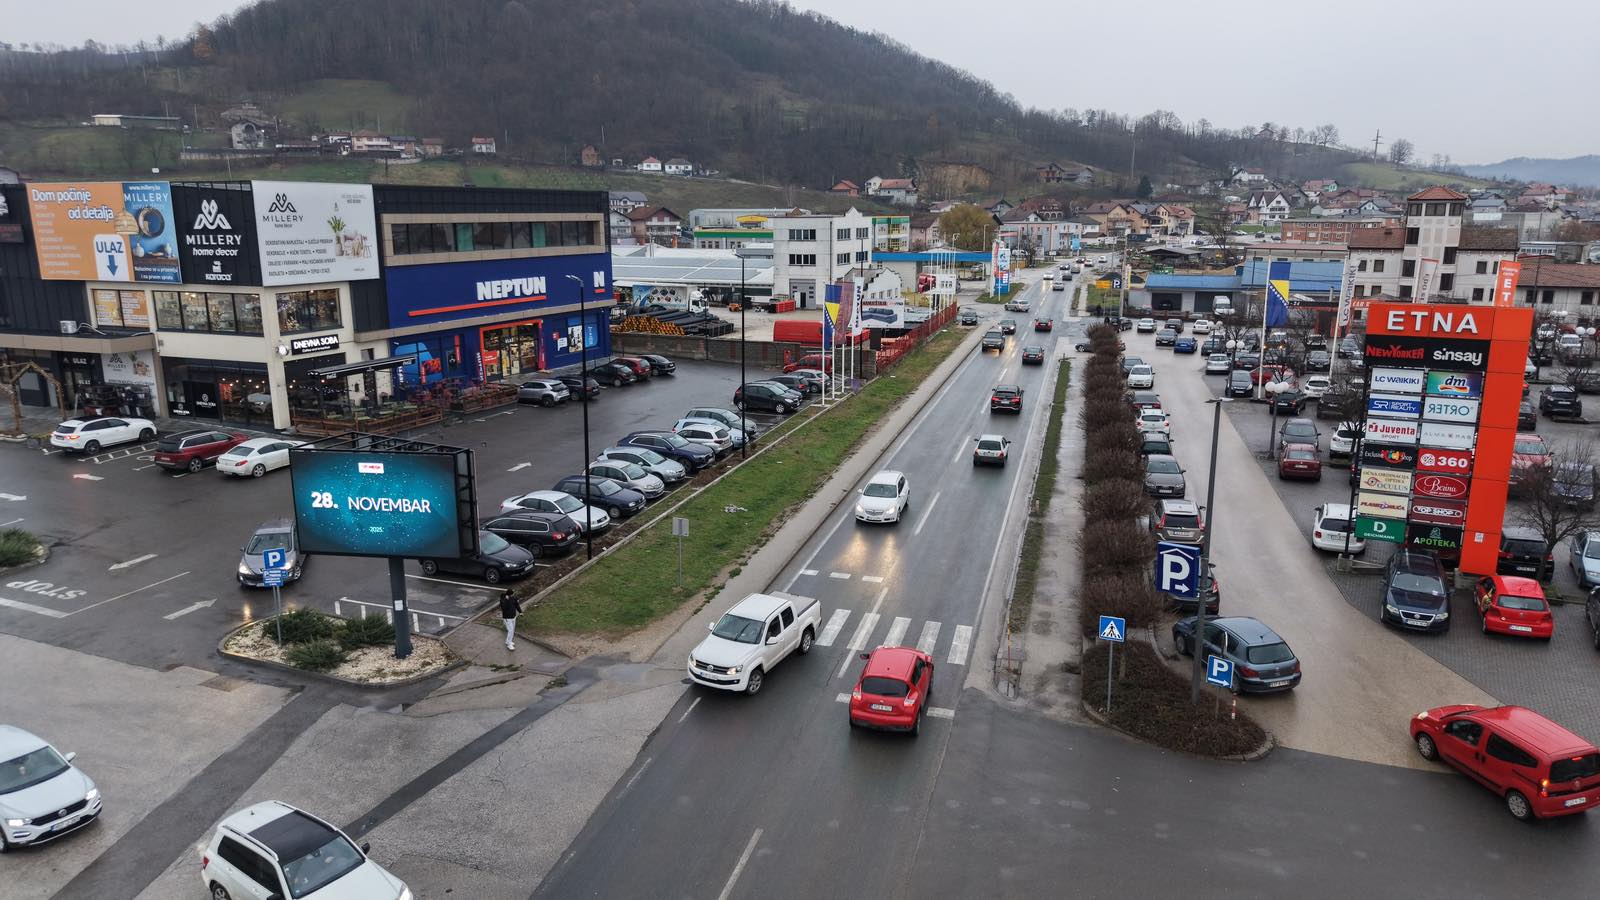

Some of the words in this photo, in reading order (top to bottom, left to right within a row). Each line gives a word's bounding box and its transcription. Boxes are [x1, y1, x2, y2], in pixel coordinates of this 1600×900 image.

[32, 189, 55, 201] Dom
[58, 188, 91, 203] počinje
[124, 192, 168, 201] MILLERY
[68, 207, 81, 219] od
[82, 206, 114, 222] detalja
[186, 234, 241, 245] MILLERY
[95, 241, 124, 254] ULAZ
[192, 247, 214, 256] home
[215, 247, 239, 256] decor
[593, 271, 605, 288] N
[477, 276, 547, 300] NEPTUN
[1387, 310, 1479, 334] ETNA
[293, 339, 321, 350] DNEVNA
[320, 336, 339, 346] SOBA
[1433, 348, 1483, 366] sinsay
[1374, 375, 1386, 383] LC
[1444, 375, 1467, 387] dm
[1380, 424, 1416, 436] Juventa
[1437, 456, 1469, 469] 360
[1376, 483, 1409, 491] OCULUS
[311, 491, 340, 509] 28.
[348, 496, 431, 514] NOVEMBAR
[1373, 521, 1387, 533] D
[1363, 532, 1396, 540] DEICHMANN
[1413, 536, 1457, 548] APOTEKA
[268, 552, 281, 567] P
[1162, 553, 1191, 591] P
[6, 580, 87, 600] STOP
[1212, 658, 1229, 677] P
